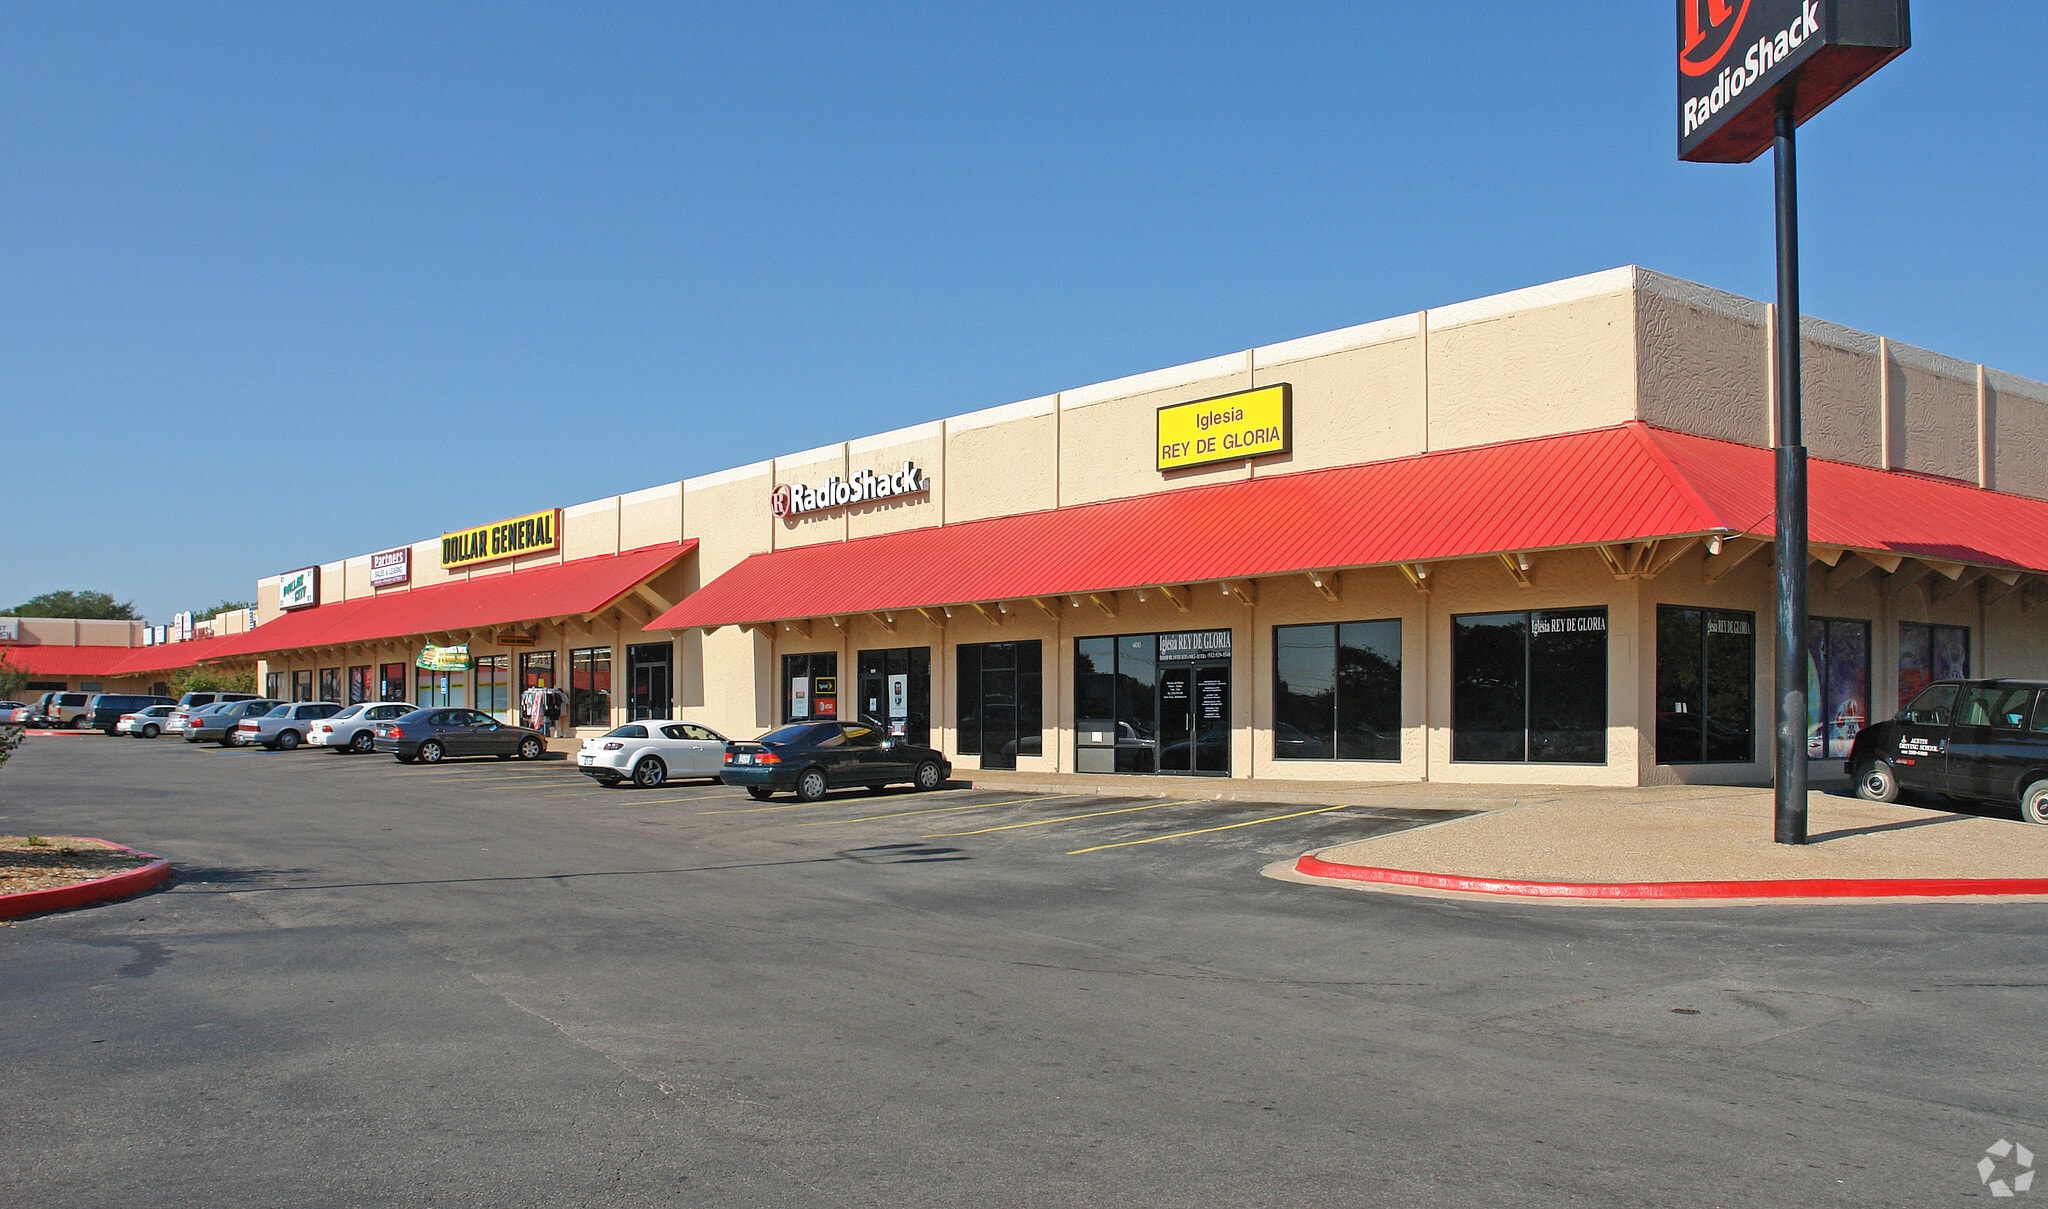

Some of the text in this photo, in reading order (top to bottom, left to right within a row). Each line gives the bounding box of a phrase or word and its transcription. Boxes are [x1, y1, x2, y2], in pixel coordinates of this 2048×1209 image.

[1684, 0, 1820, 138] RadioShack
[1196, 407, 1244, 431] Iglesia
[1162, 426, 1280, 460] REY DE GLORIA
[790, 461, 921, 514] RadioShack
[442, 515, 553, 565] DOLLAR GENERAL
[374, 551, 404, 569] Partners
[1531, 616, 1606, 637] Iglesia REY DE GLORIA
[1707, 619, 1718, 636] glesia
[1160, 631, 1231, 655] Iglesia REY DE GLORIA
[1919, 744, 1939, 752] SCHOOL
